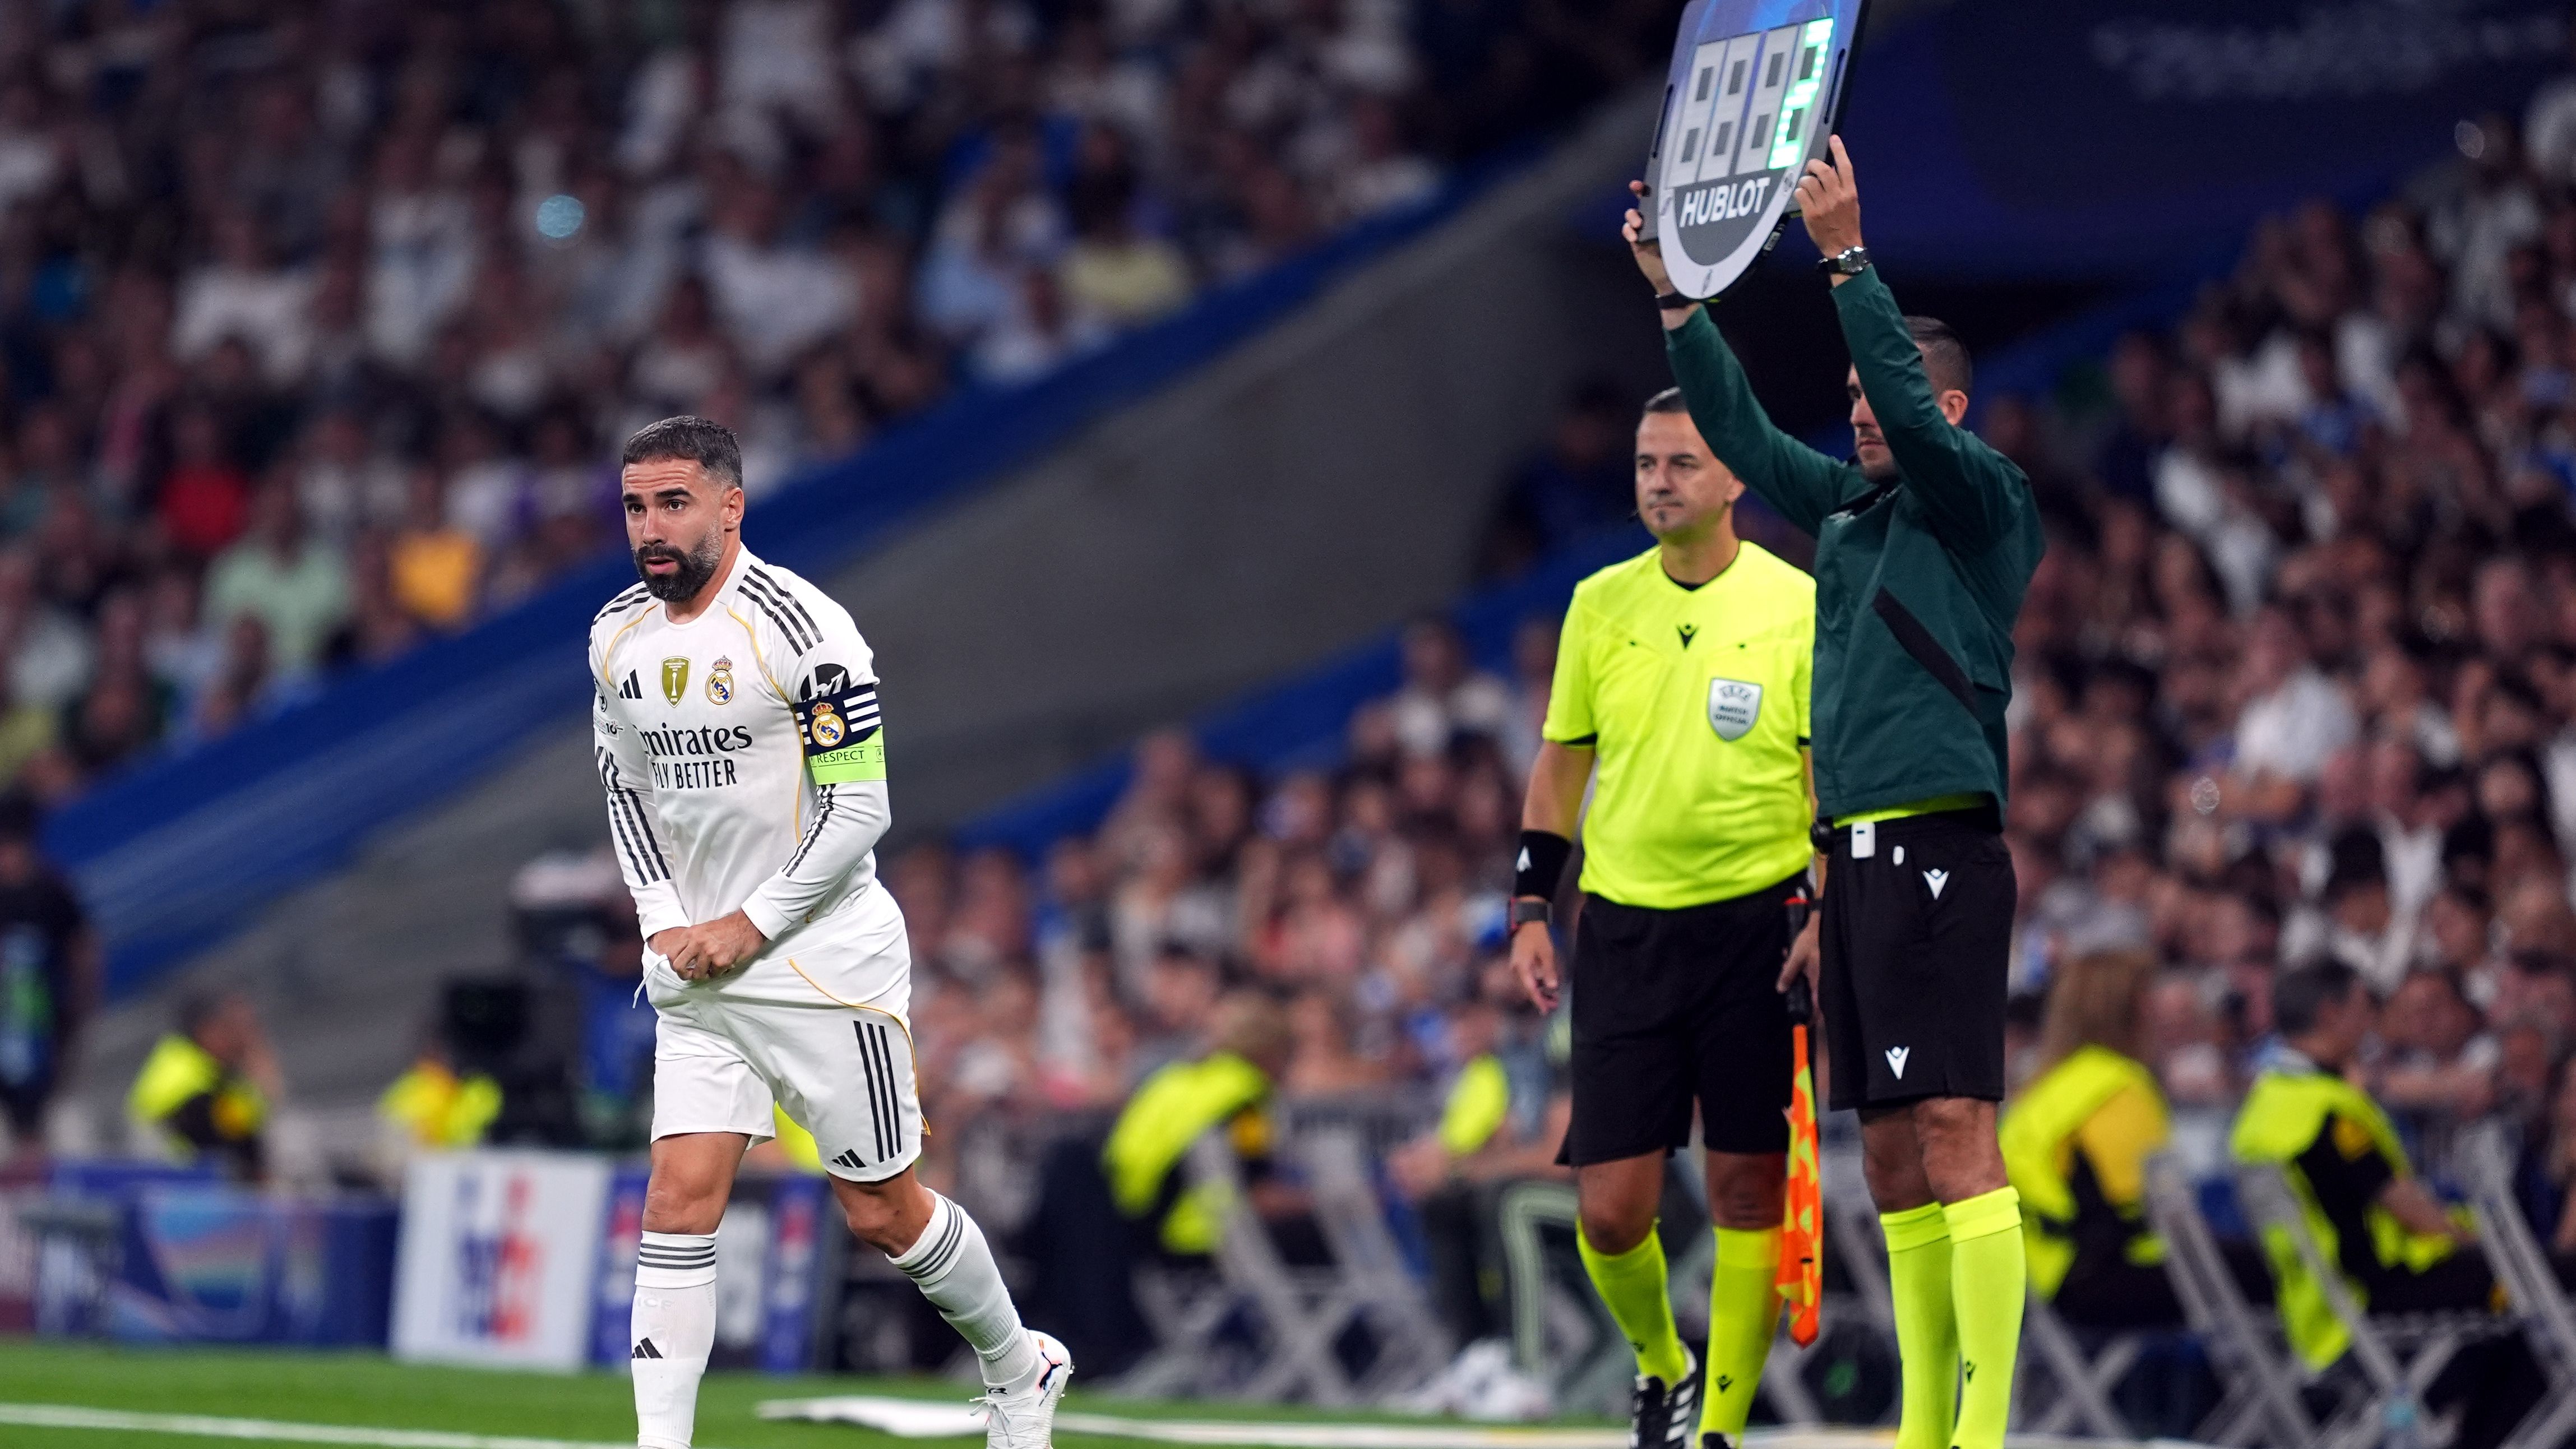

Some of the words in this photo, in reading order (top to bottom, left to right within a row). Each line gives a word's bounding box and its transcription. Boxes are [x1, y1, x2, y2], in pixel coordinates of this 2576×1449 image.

[1769, 17, 1833, 170] 2
[1681, 177, 1770, 228] HUBLOT
[632, 722, 752, 756] mirates
[817, 750, 865, 763] RESPECT
[674, 759, 737, 789] BETTER
